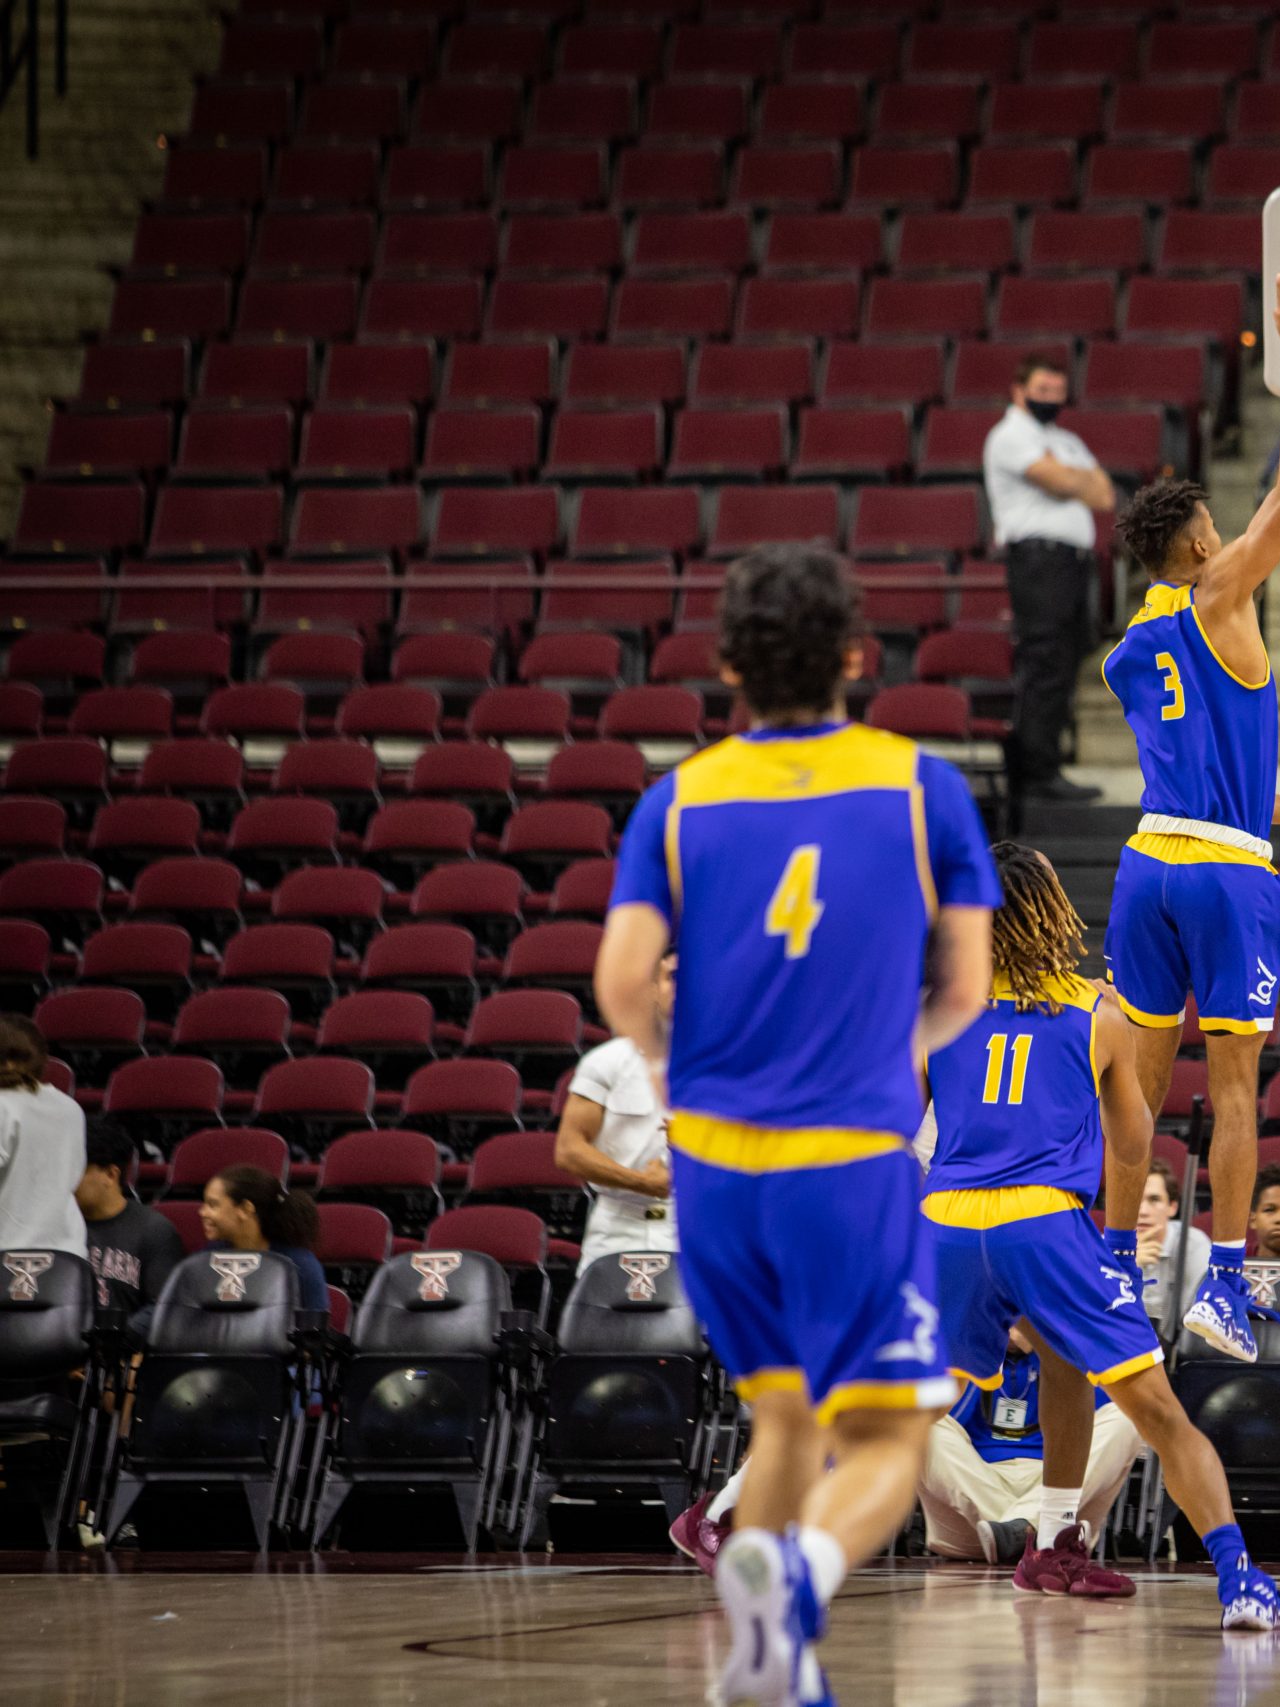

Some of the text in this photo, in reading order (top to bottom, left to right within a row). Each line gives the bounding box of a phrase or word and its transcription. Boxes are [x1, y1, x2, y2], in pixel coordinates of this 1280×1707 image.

[1155, 652, 1186, 721] 3
[764, 843, 826, 960] 4
[982, 1033, 1034, 1104] 11
